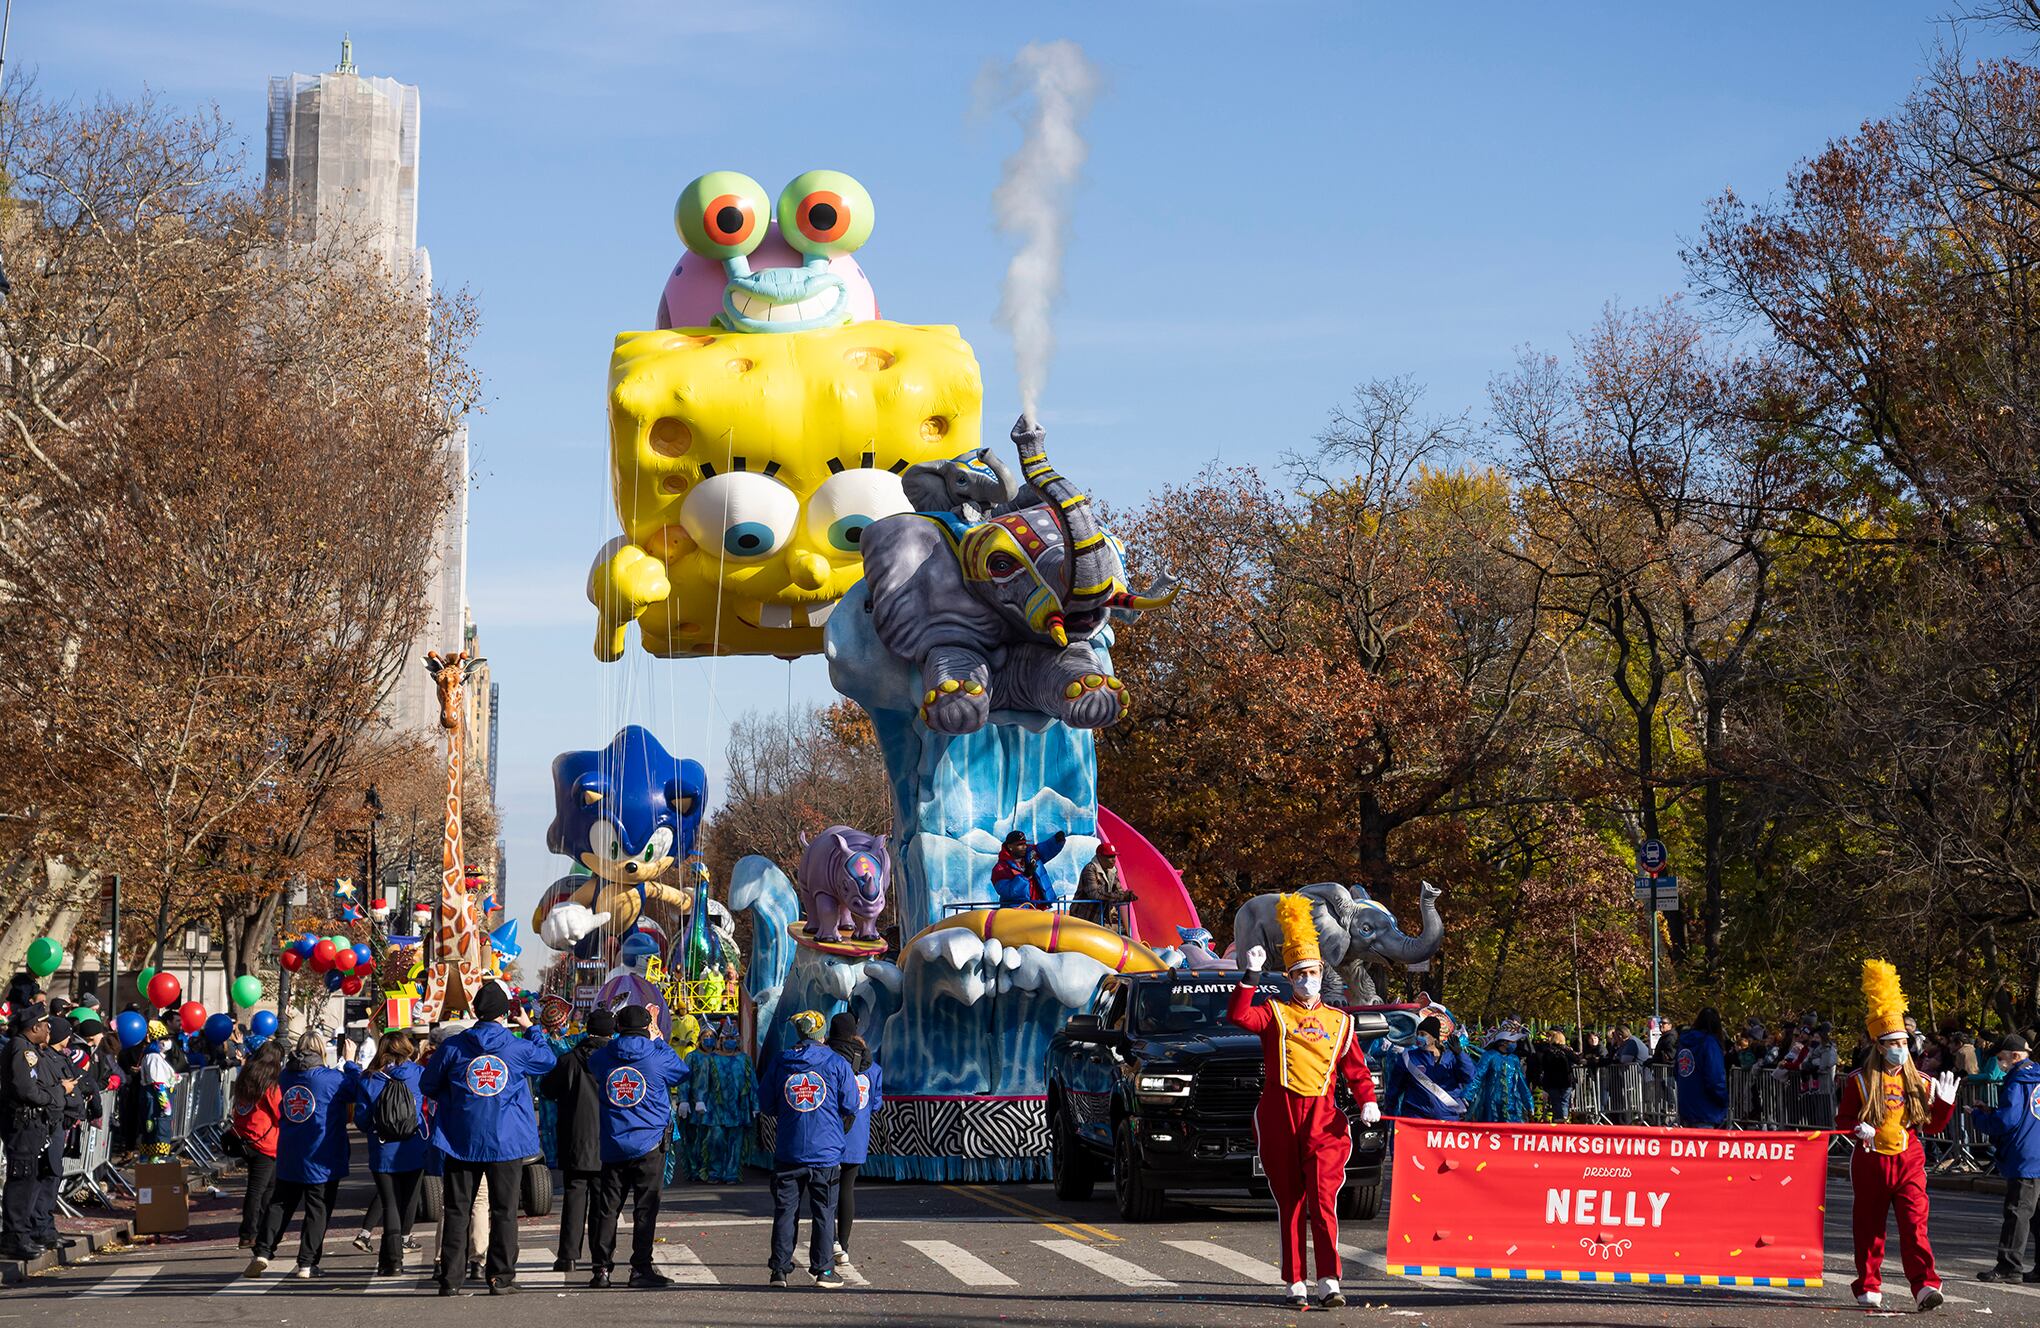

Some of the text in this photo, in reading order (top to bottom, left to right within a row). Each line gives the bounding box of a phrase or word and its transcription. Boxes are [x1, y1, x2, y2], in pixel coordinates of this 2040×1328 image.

[1171, 983, 1281, 994] #RAMTRCKS
[1427, 1131, 1796, 1161] MACY'S THANKSGIVING DAY PARADE
[1583, 1166, 1633, 1180] presents
[1545, 1188, 1671, 1228] NELLY
